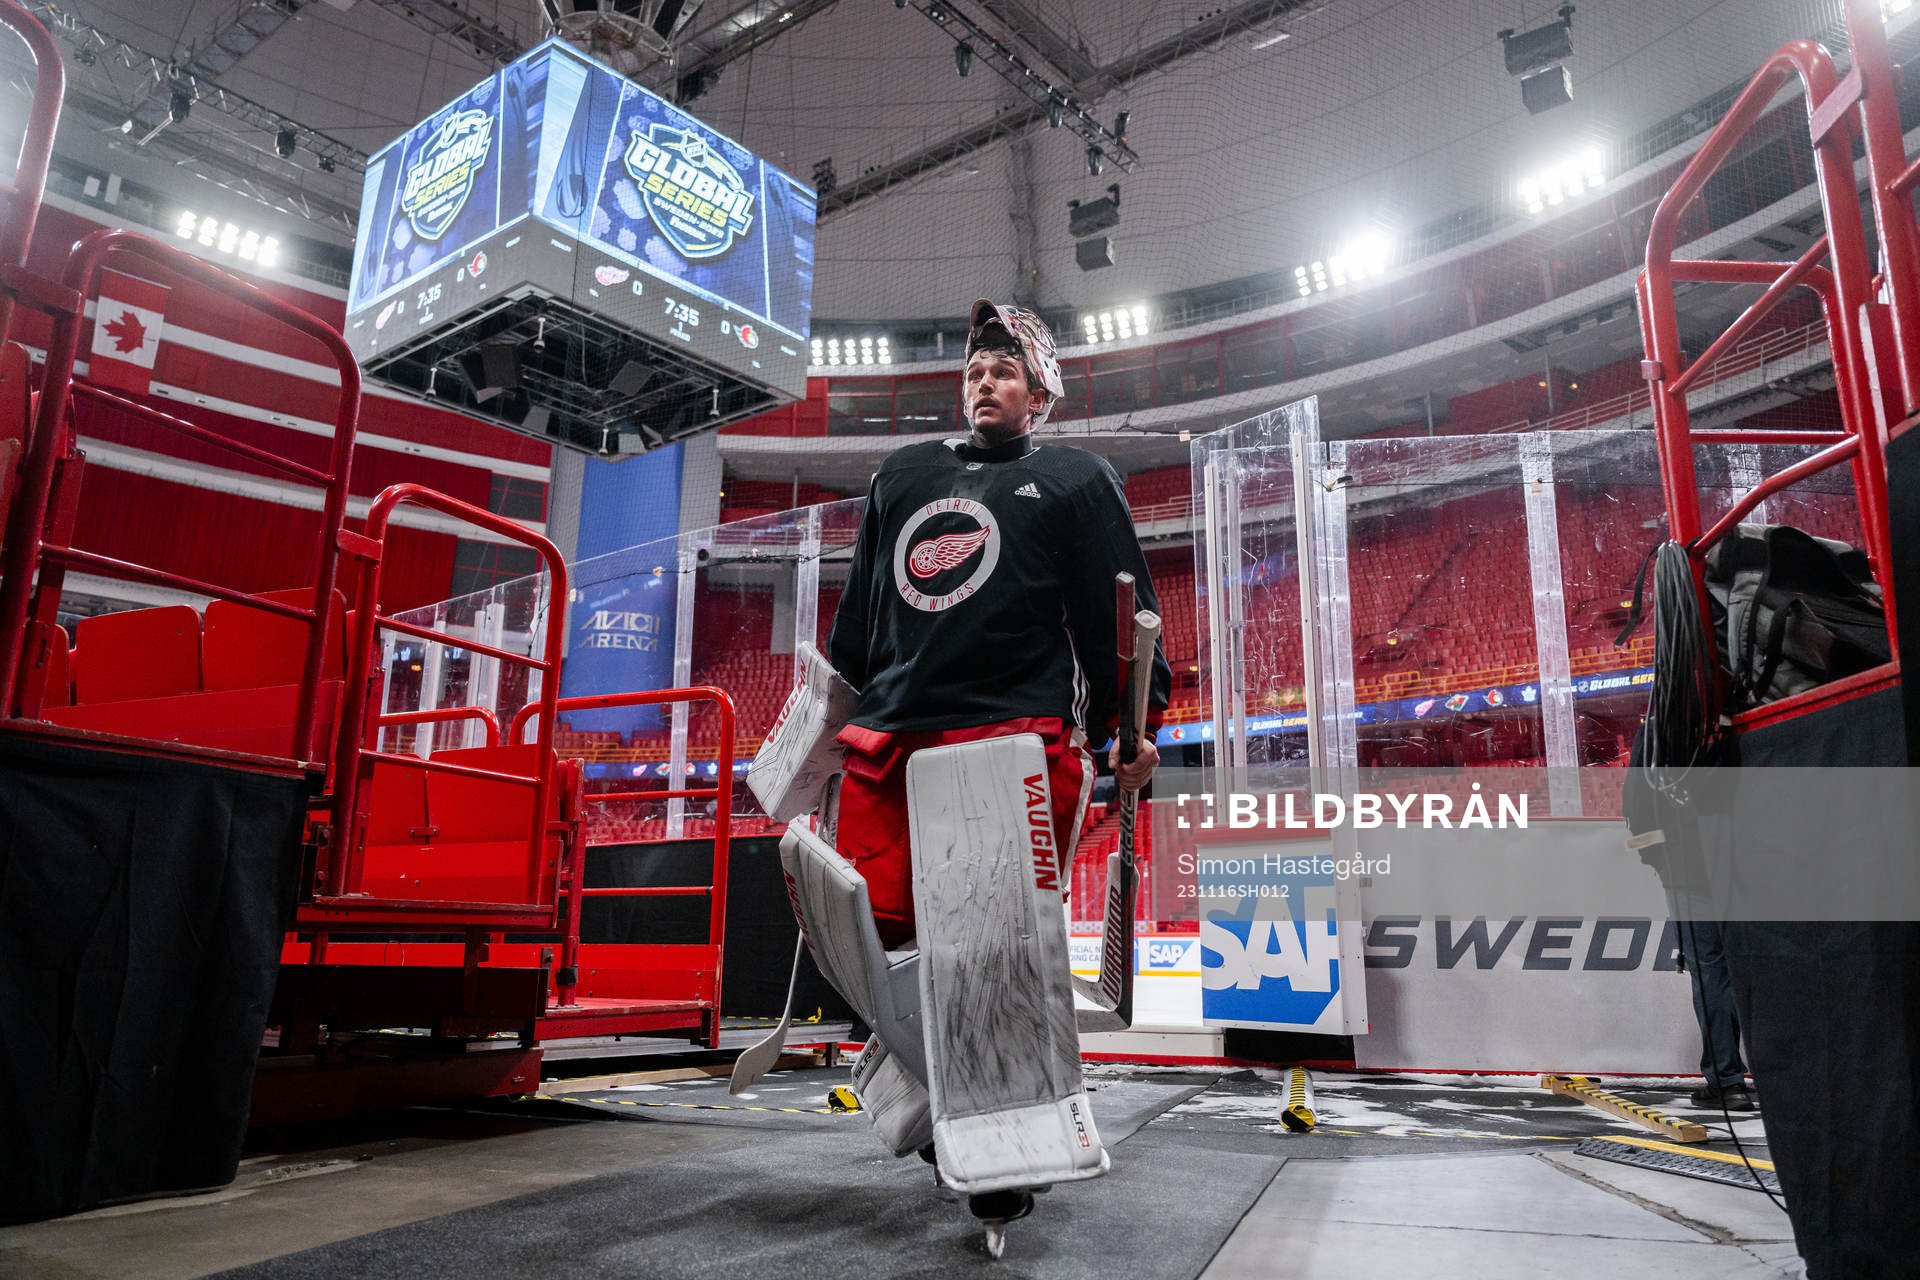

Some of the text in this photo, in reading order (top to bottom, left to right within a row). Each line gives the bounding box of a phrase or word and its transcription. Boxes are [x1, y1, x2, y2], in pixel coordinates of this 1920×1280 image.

[405, 122, 489, 202] GLOBAL
[413, 160, 471, 209] SERIES
[629, 137, 750, 224] GLOBAL
[643, 173, 729, 228] SERIES
[416, 283, 443, 310] 7:35
[632, 280, 643, 296] 0
[664, 297, 700, 327] 7:35
[720, 320, 731, 335] 0
[926, 499, 985, 516] DETROIT
[1014, 489, 1041, 499] adidas
[901, 582, 975, 611] RED WINGS
[578, 633, 658, 652] ARENA
[1589, 676, 1632, 692] GLOBAL
[1023, 773, 1059, 891] VAUGHN
[1102, 885, 1122, 1004] WARRIOR
[1150, 945, 1183, 963] SAP
[1364, 915, 1683, 972] SWED
[1070, 1102, 1090, 1148] SLR3
